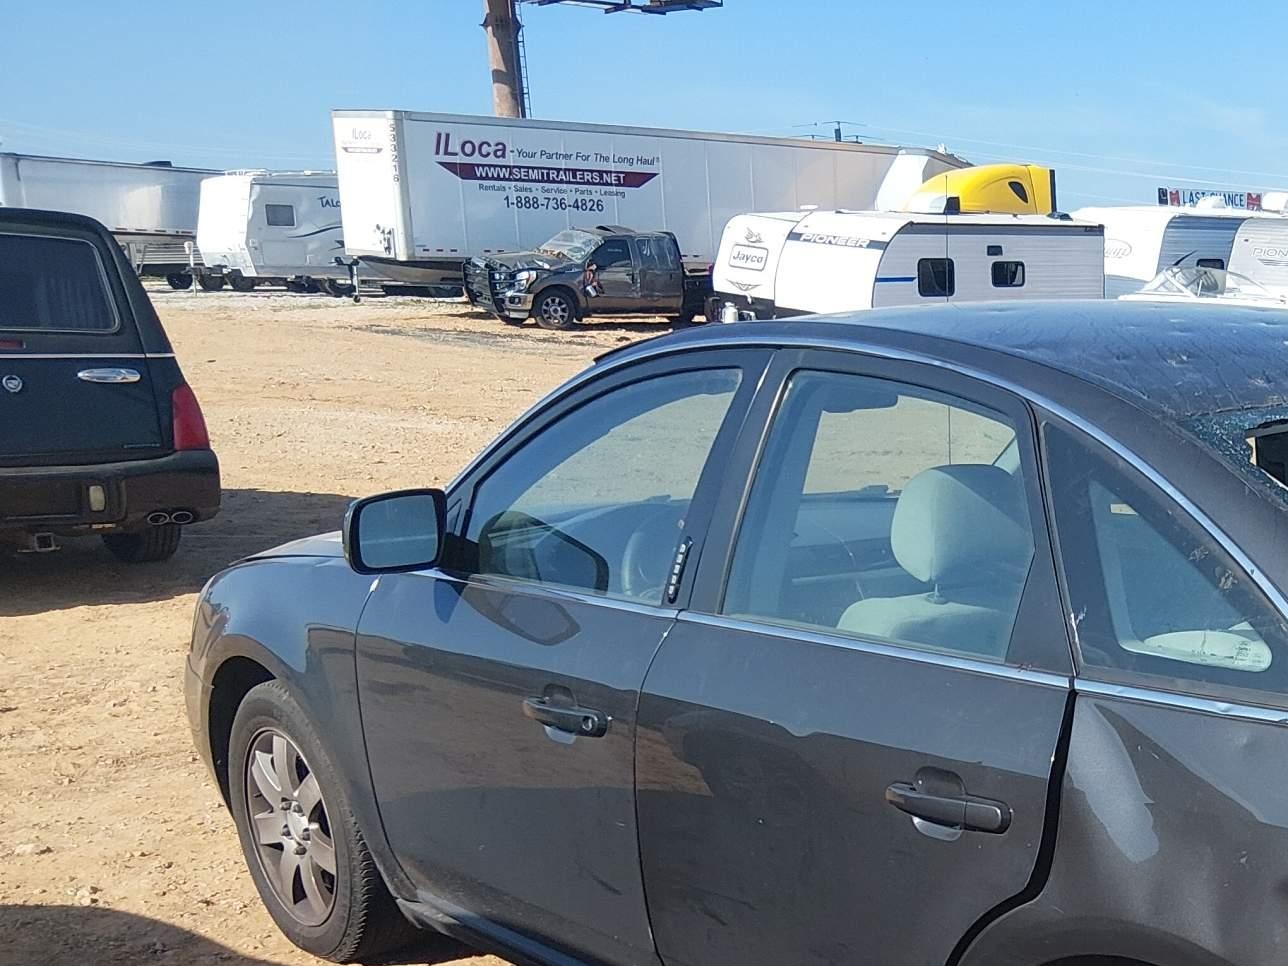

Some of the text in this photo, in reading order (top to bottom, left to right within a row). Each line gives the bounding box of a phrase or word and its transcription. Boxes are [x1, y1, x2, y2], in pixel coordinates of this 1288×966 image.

[434, 132, 507, 159] ILoca
[516, 149, 538, 159] Your
[540, 150, 573, 161] Partner
[576, 152, 591, 162] For
[593, 153, 610, 163] The
[612, 154, 634, 167] Long
[474, 166, 626, 184] WWW.SEMITRAILERS.NET
[478, 184, 626, 199] Rentals Sales Service Parts Leasing
[503, 195, 604, 212] 1-888-736-4826
[800, 233, 872, 248] PIONEER
[733, 251, 763, 264] Jayco
